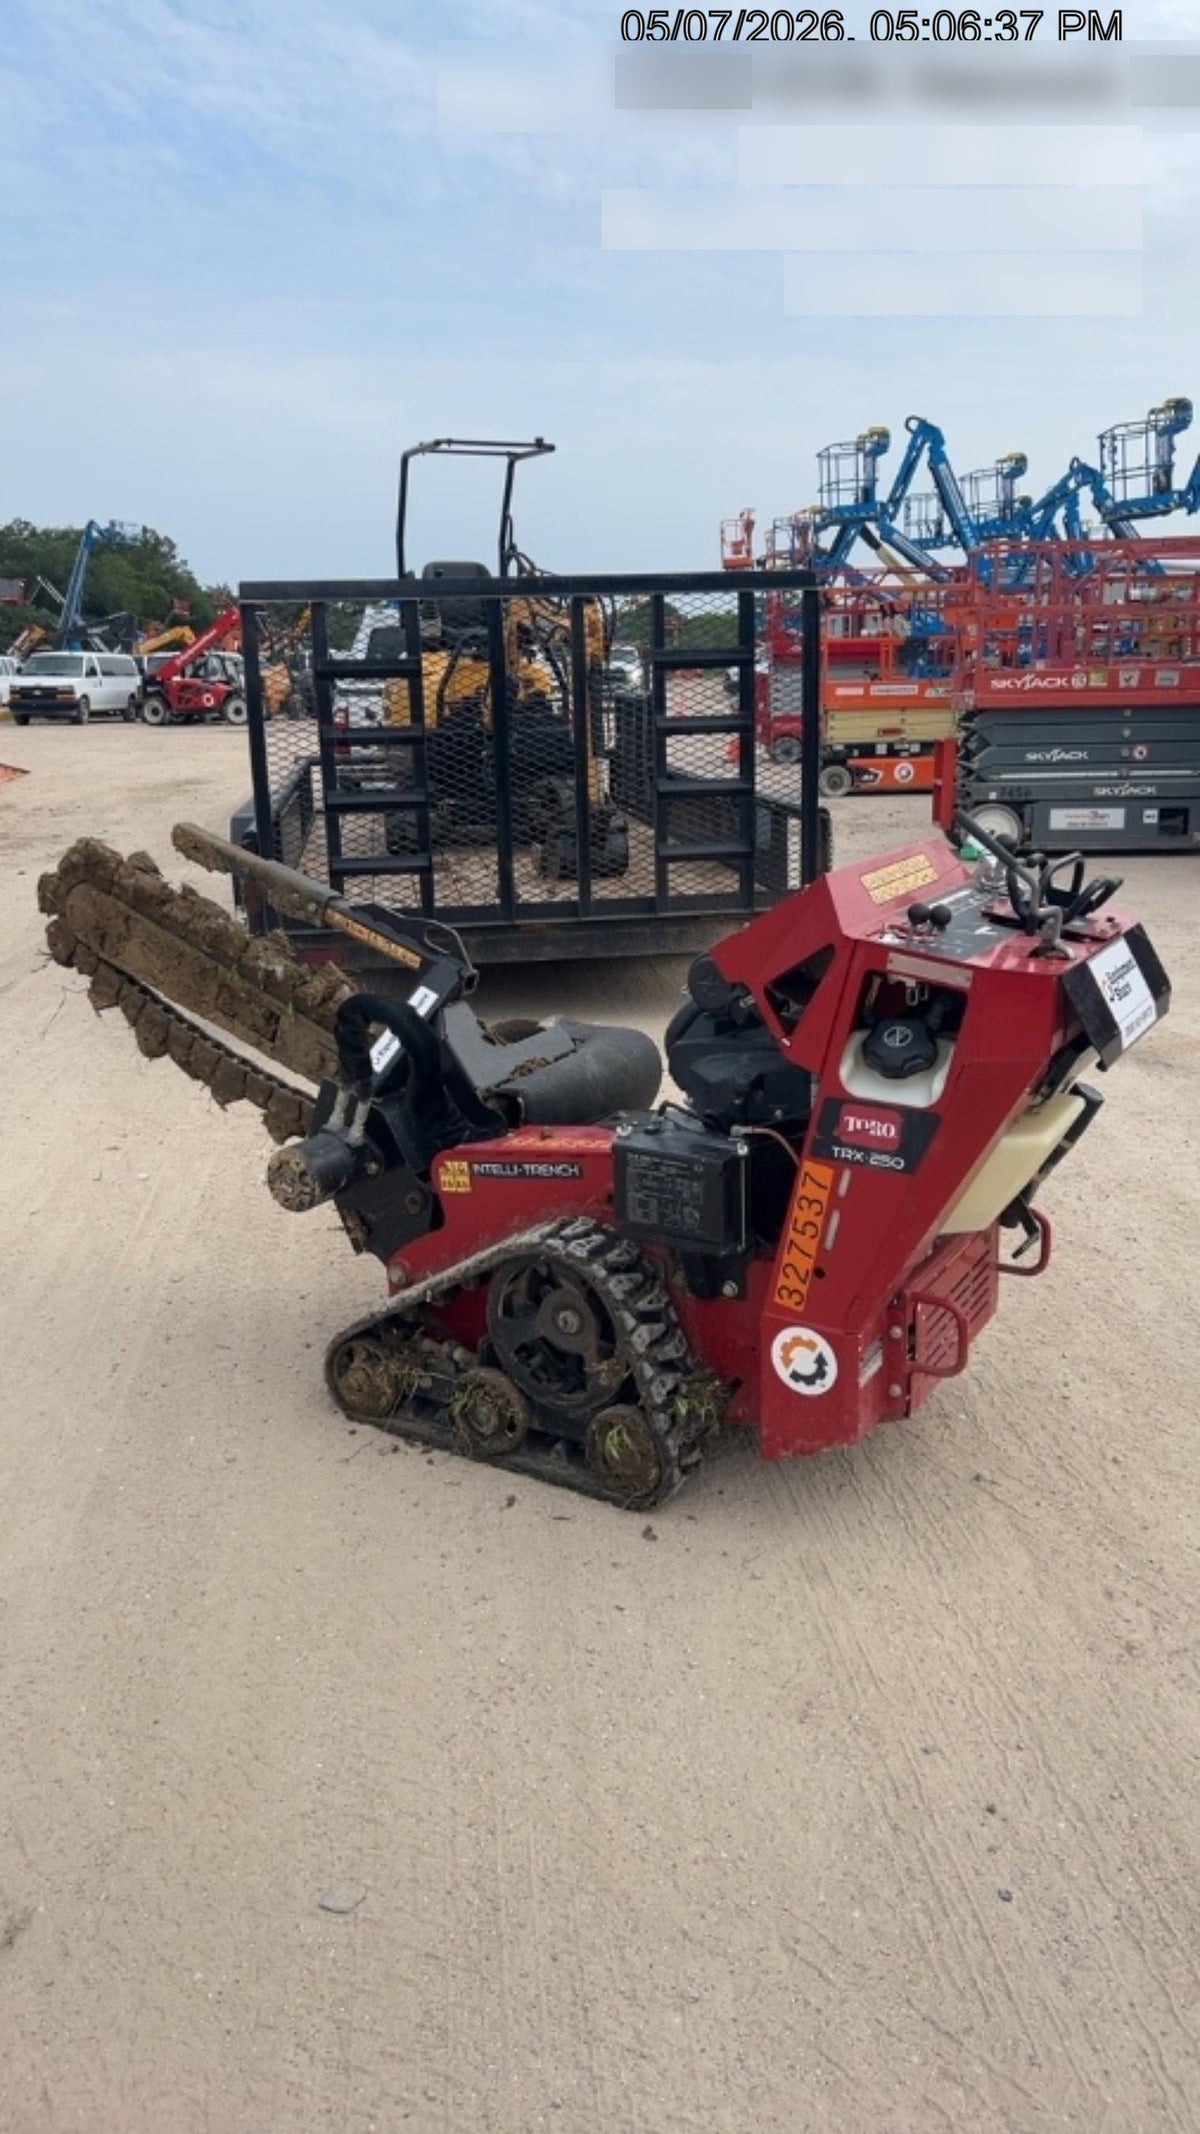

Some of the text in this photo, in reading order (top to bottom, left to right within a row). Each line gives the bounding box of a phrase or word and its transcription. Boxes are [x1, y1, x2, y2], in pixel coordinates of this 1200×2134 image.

[990, 673, 1068, 690] SKYJACK
[1025, 748, 1088, 762] SKYJACK
[1092, 782, 1156, 797] SKYJACK
[843, 1116, 897, 1138] TORO
[472, 1163, 580, 1177] INTELLI-TRENCH
[777, 1170, 829, 1307] 327537
